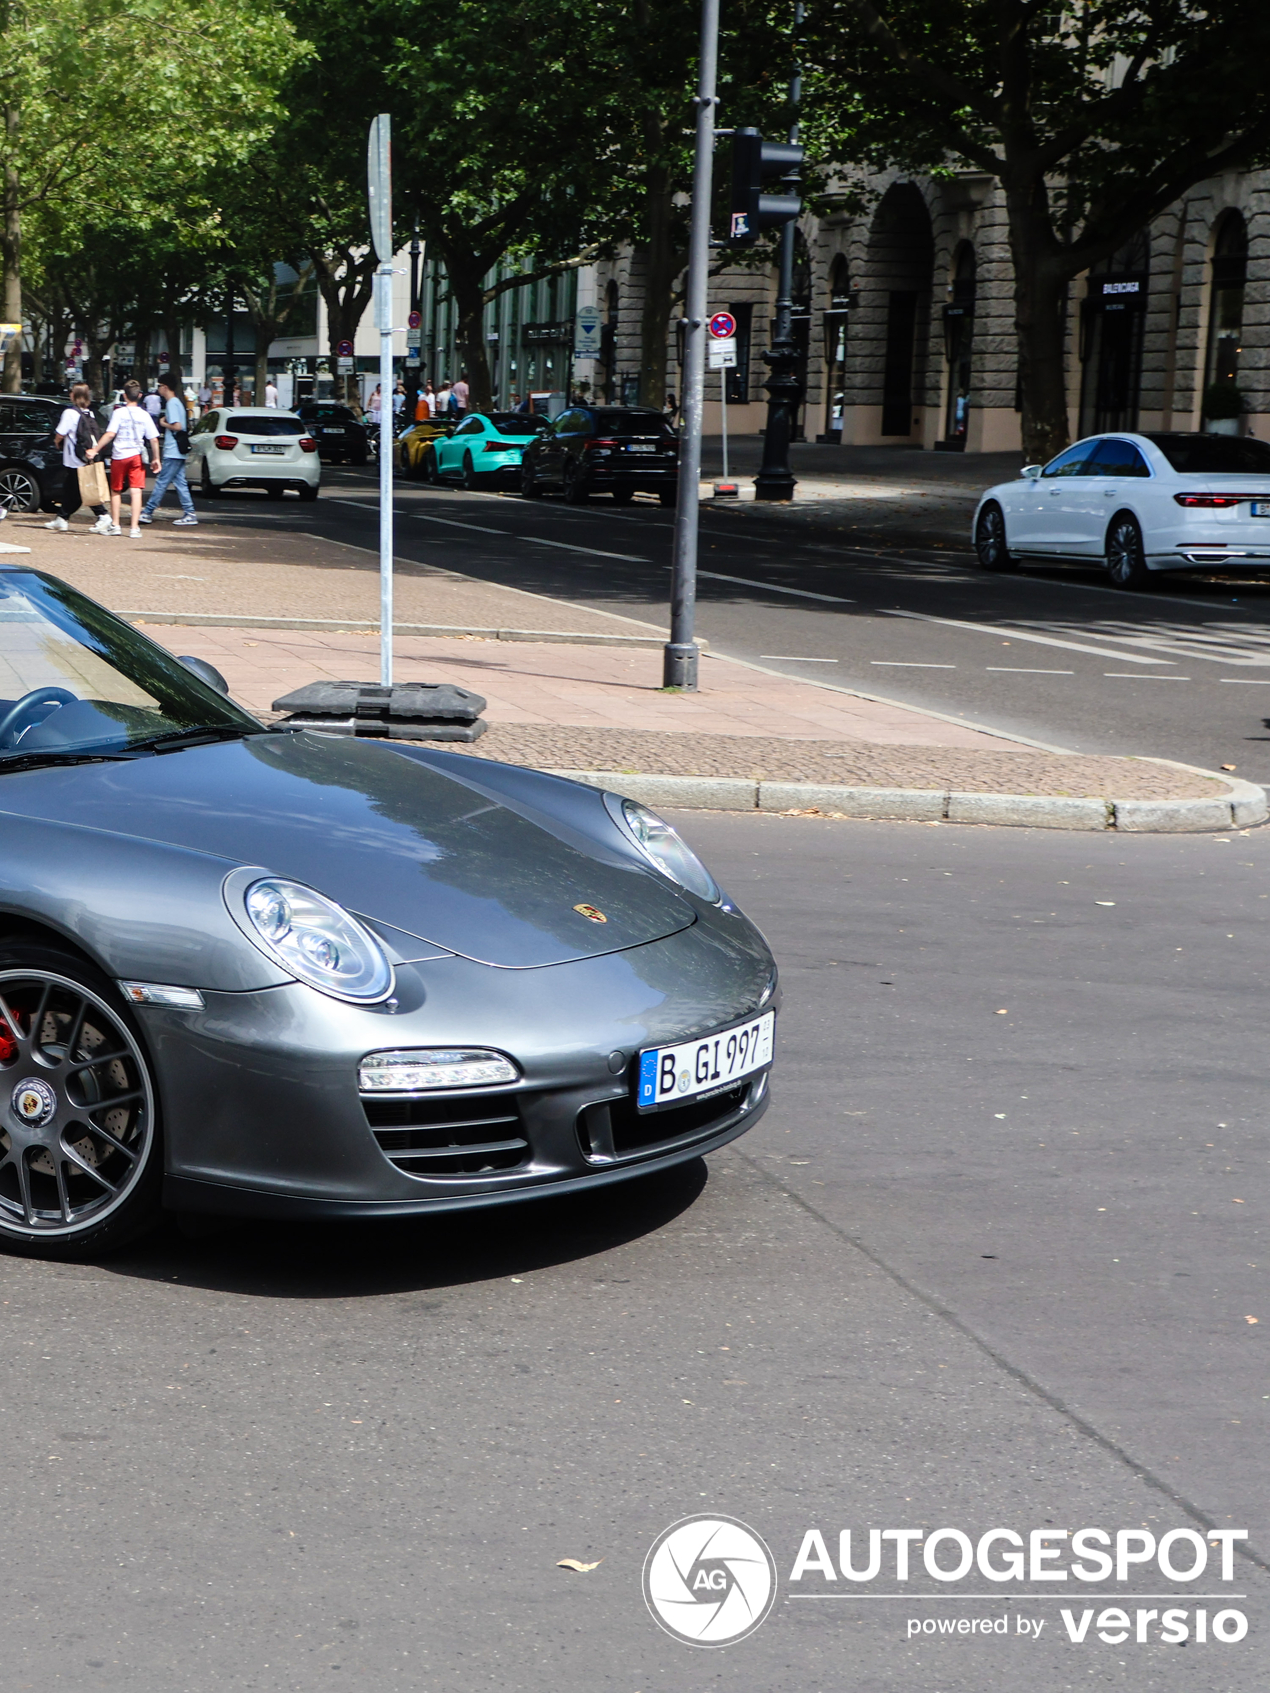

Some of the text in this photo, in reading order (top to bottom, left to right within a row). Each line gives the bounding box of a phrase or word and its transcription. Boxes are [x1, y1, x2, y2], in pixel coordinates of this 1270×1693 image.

[659, 1024, 760, 1095] B GI 997
[644, 1084, 652, 1097] D
